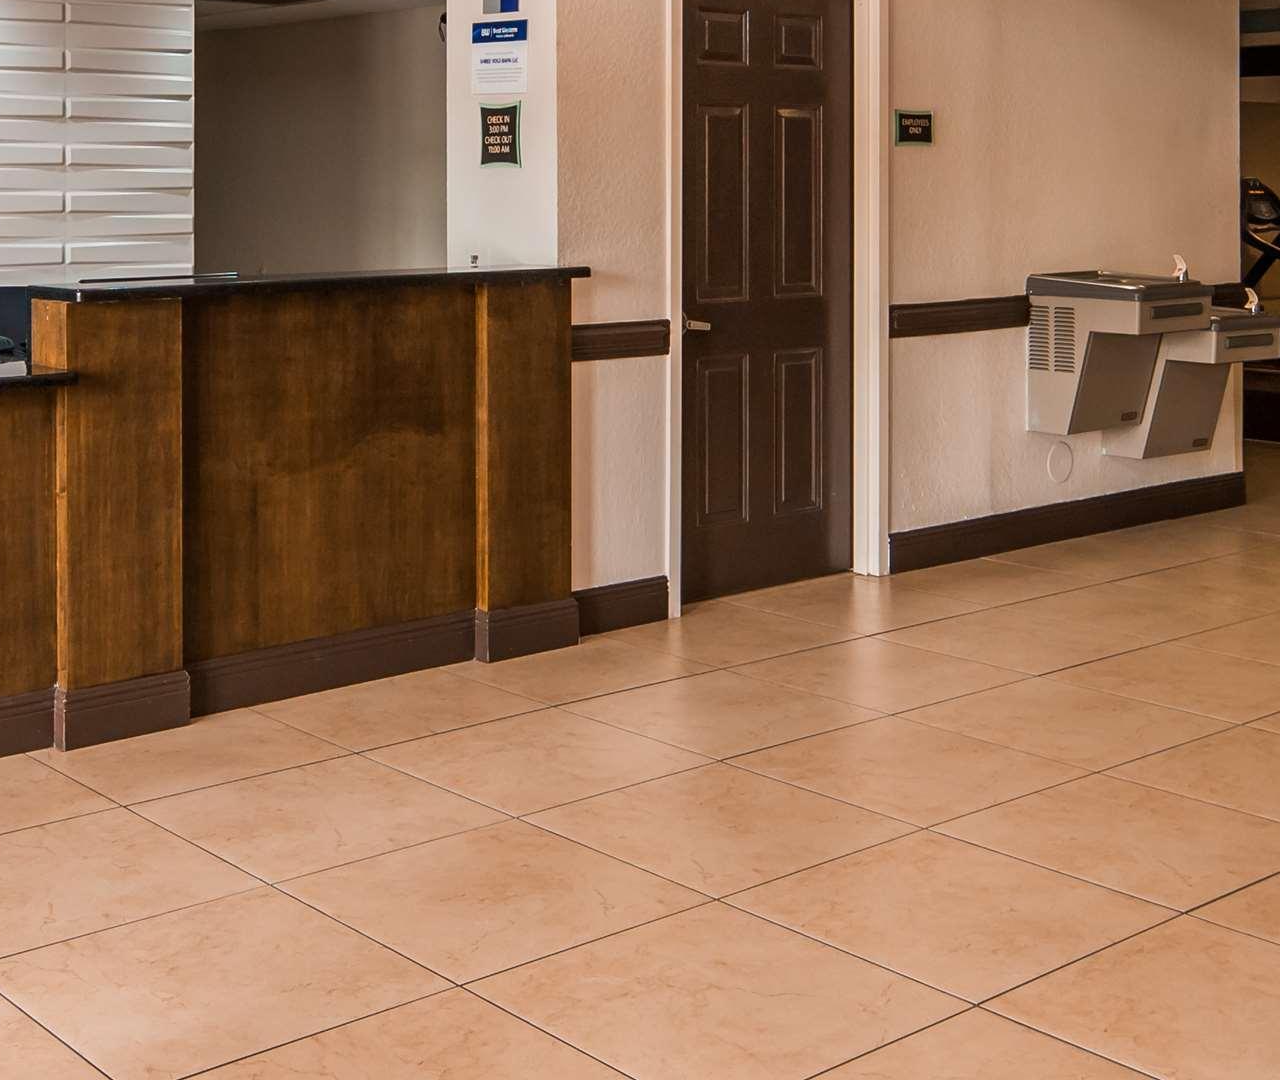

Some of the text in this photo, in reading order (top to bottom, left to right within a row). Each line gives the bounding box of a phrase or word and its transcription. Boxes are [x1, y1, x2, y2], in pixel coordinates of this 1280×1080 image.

[487, 115, 510, 124] CHECK IN
[489, 125, 508, 134] 3:00 PM
[484, 135, 512, 144] CHECK OUT
[488, 145, 510, 153] 11:00 AM
